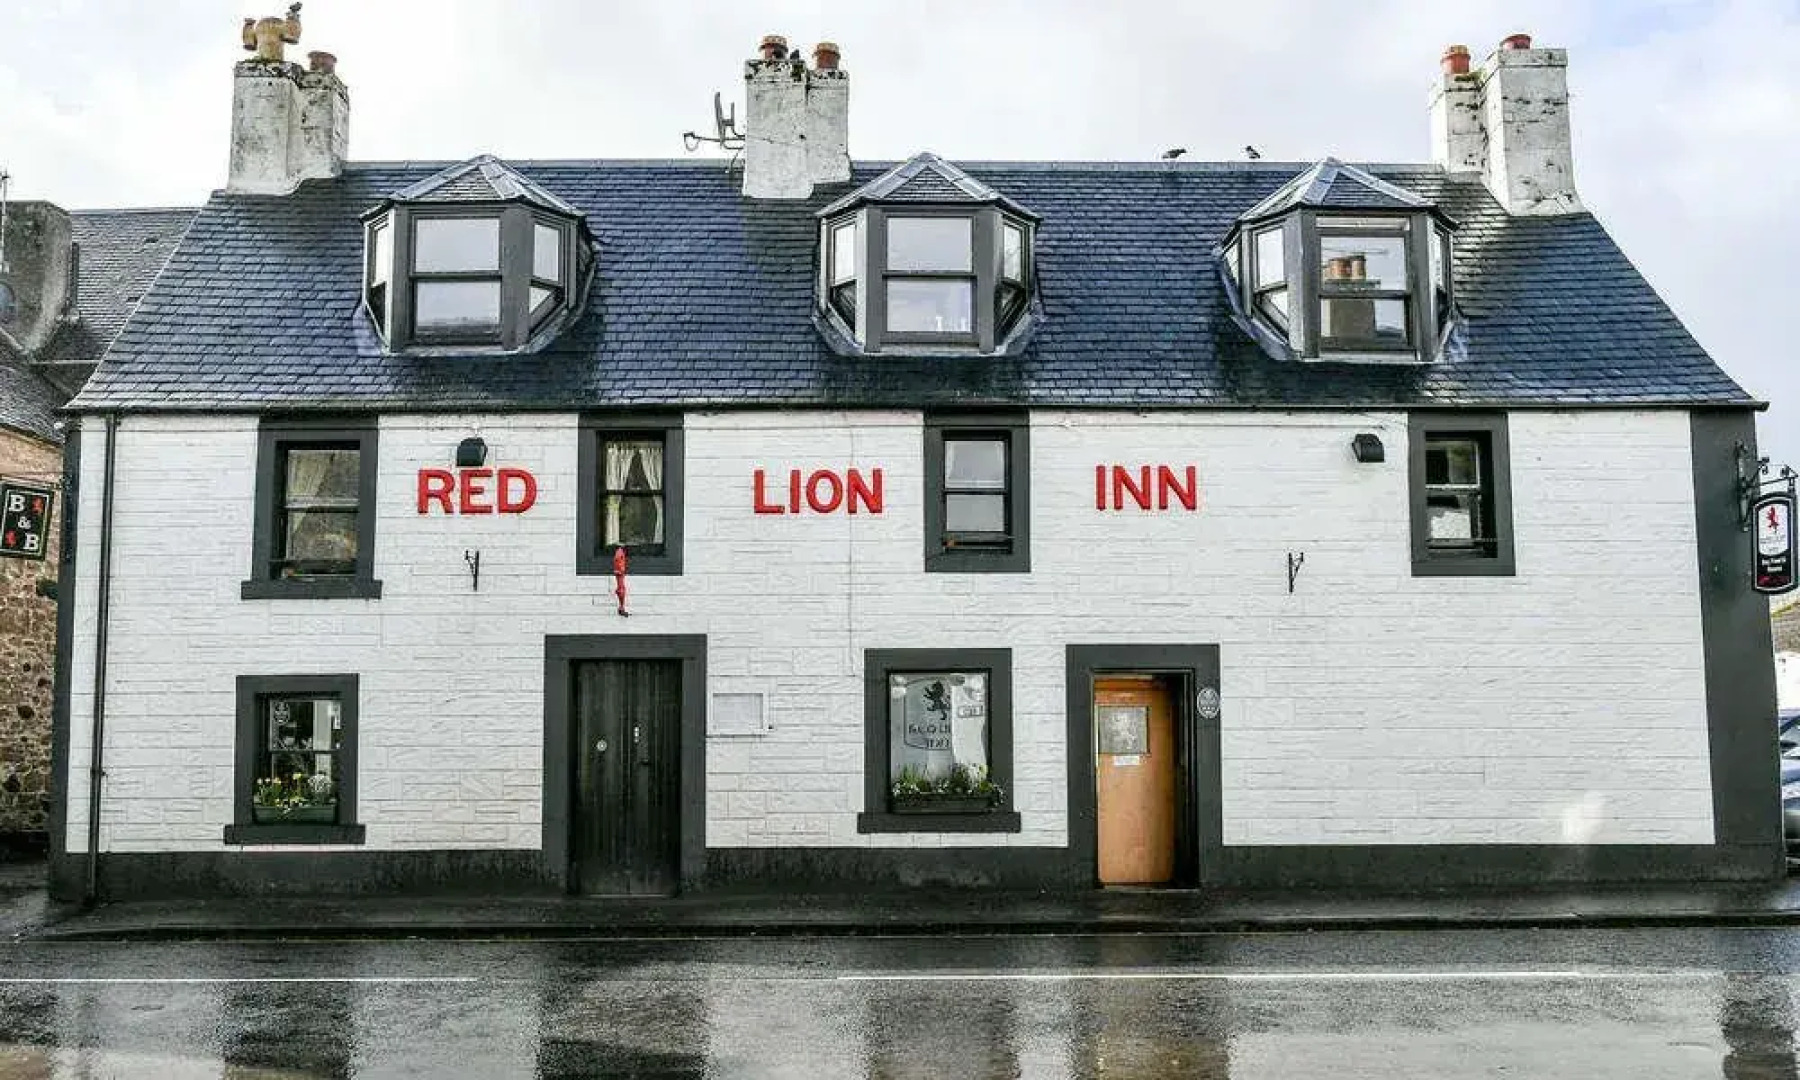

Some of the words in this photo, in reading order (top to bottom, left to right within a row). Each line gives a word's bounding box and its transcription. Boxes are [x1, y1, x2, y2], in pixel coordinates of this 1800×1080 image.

[418, 468, 537, 515] RED
[754, 468, 884, 515] LION
[1096, 466, 1197, 510] INN
[9, 494, 26, 511] B
[18, 516, 32, 530] &
[23, 532, 39, 549] B
